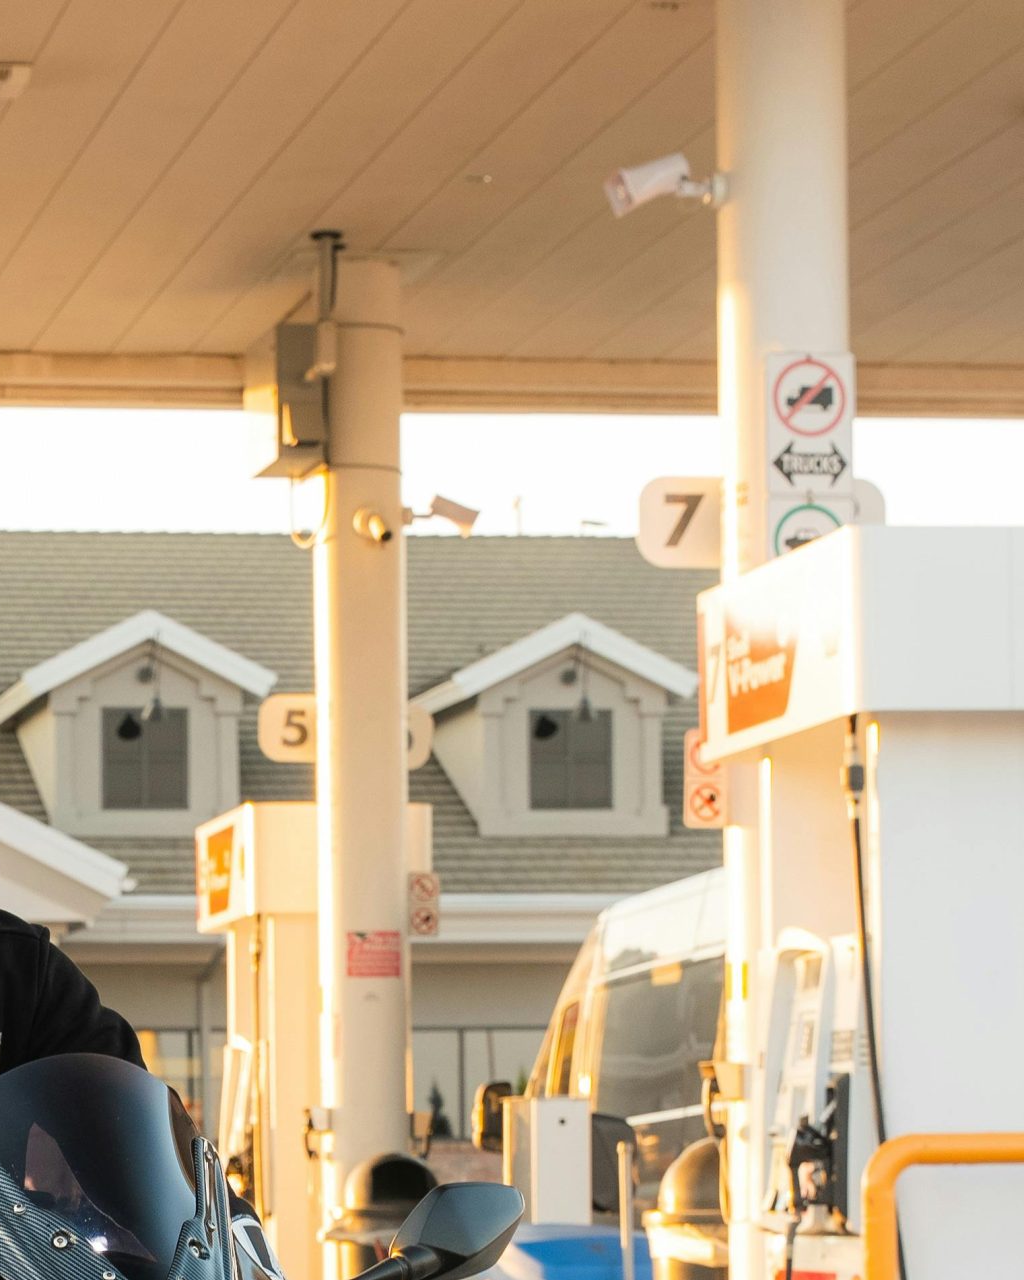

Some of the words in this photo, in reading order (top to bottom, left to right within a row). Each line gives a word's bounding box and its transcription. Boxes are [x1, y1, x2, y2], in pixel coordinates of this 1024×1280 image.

[781, 453, 843, 475] TRUCKS
[664, 494, 705, 547] 7
[281, 709, 309, 748] 5
